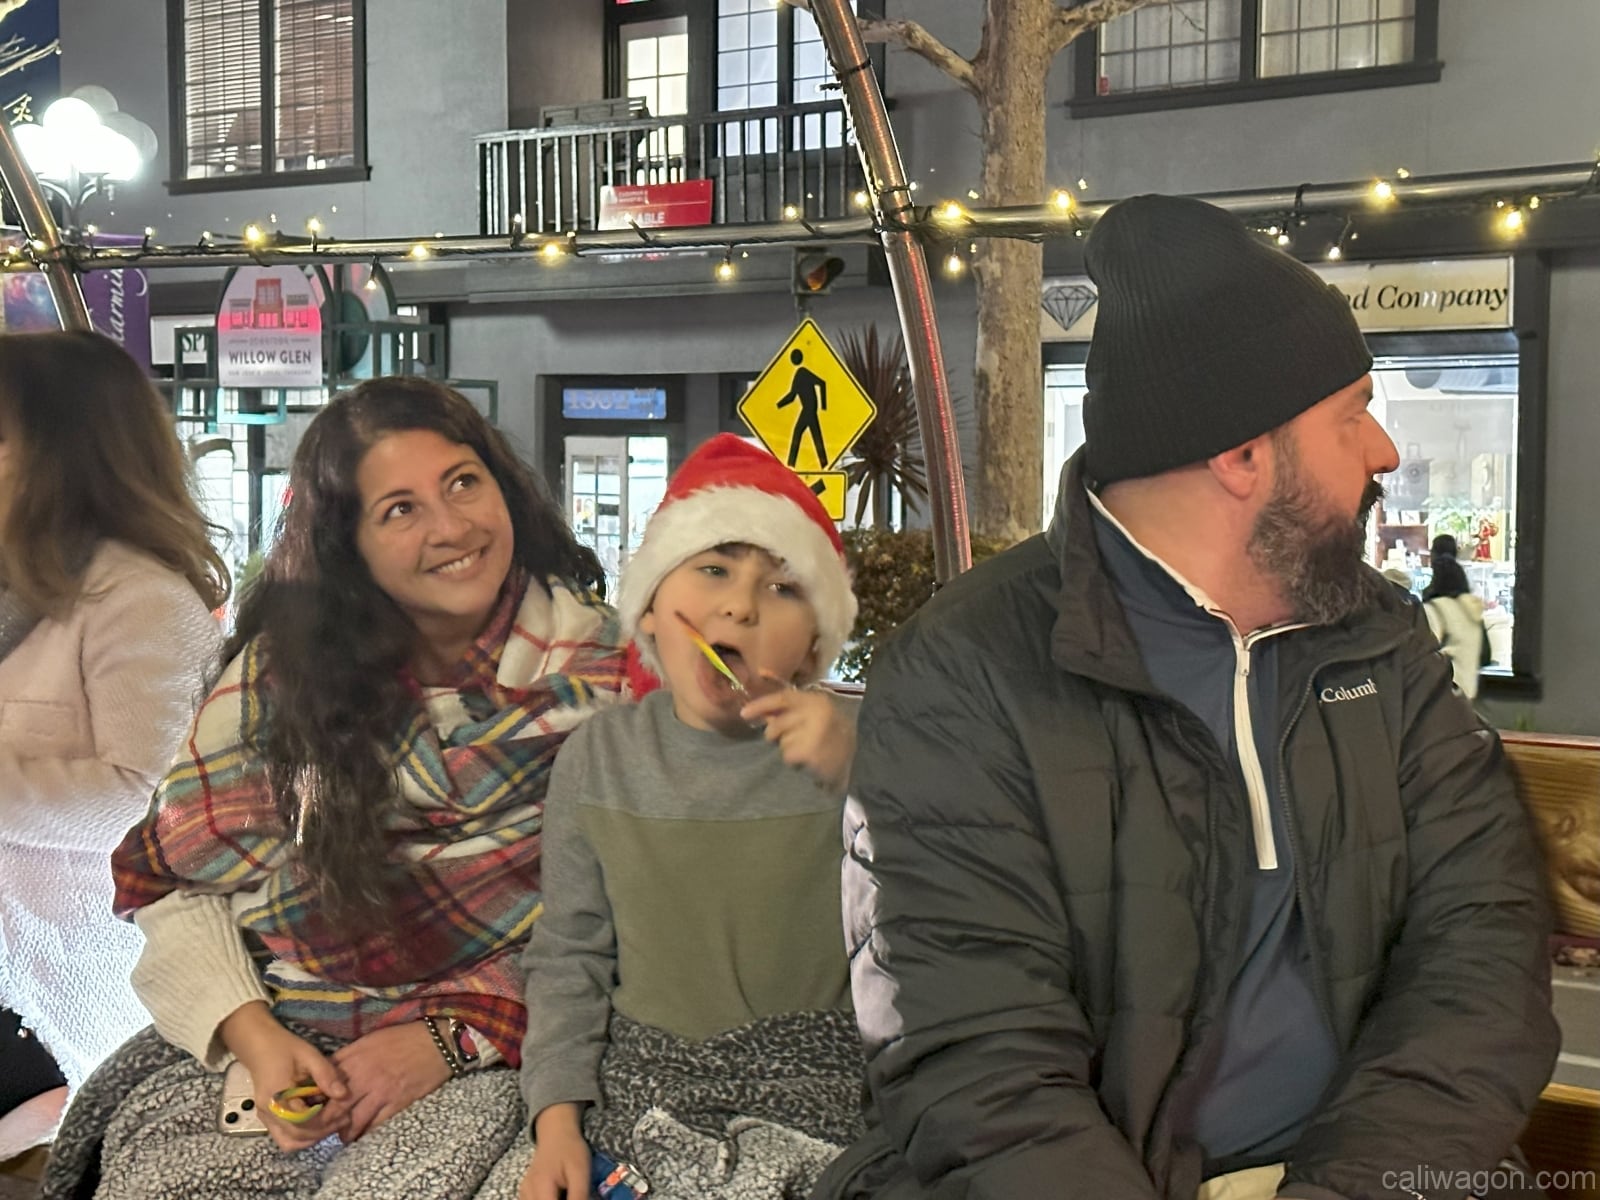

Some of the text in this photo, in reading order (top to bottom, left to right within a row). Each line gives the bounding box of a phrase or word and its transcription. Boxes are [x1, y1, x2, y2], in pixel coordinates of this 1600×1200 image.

[1377, 284, 1508, 313] Company
[228, 349, 311, 364] WILLOW GLEN
